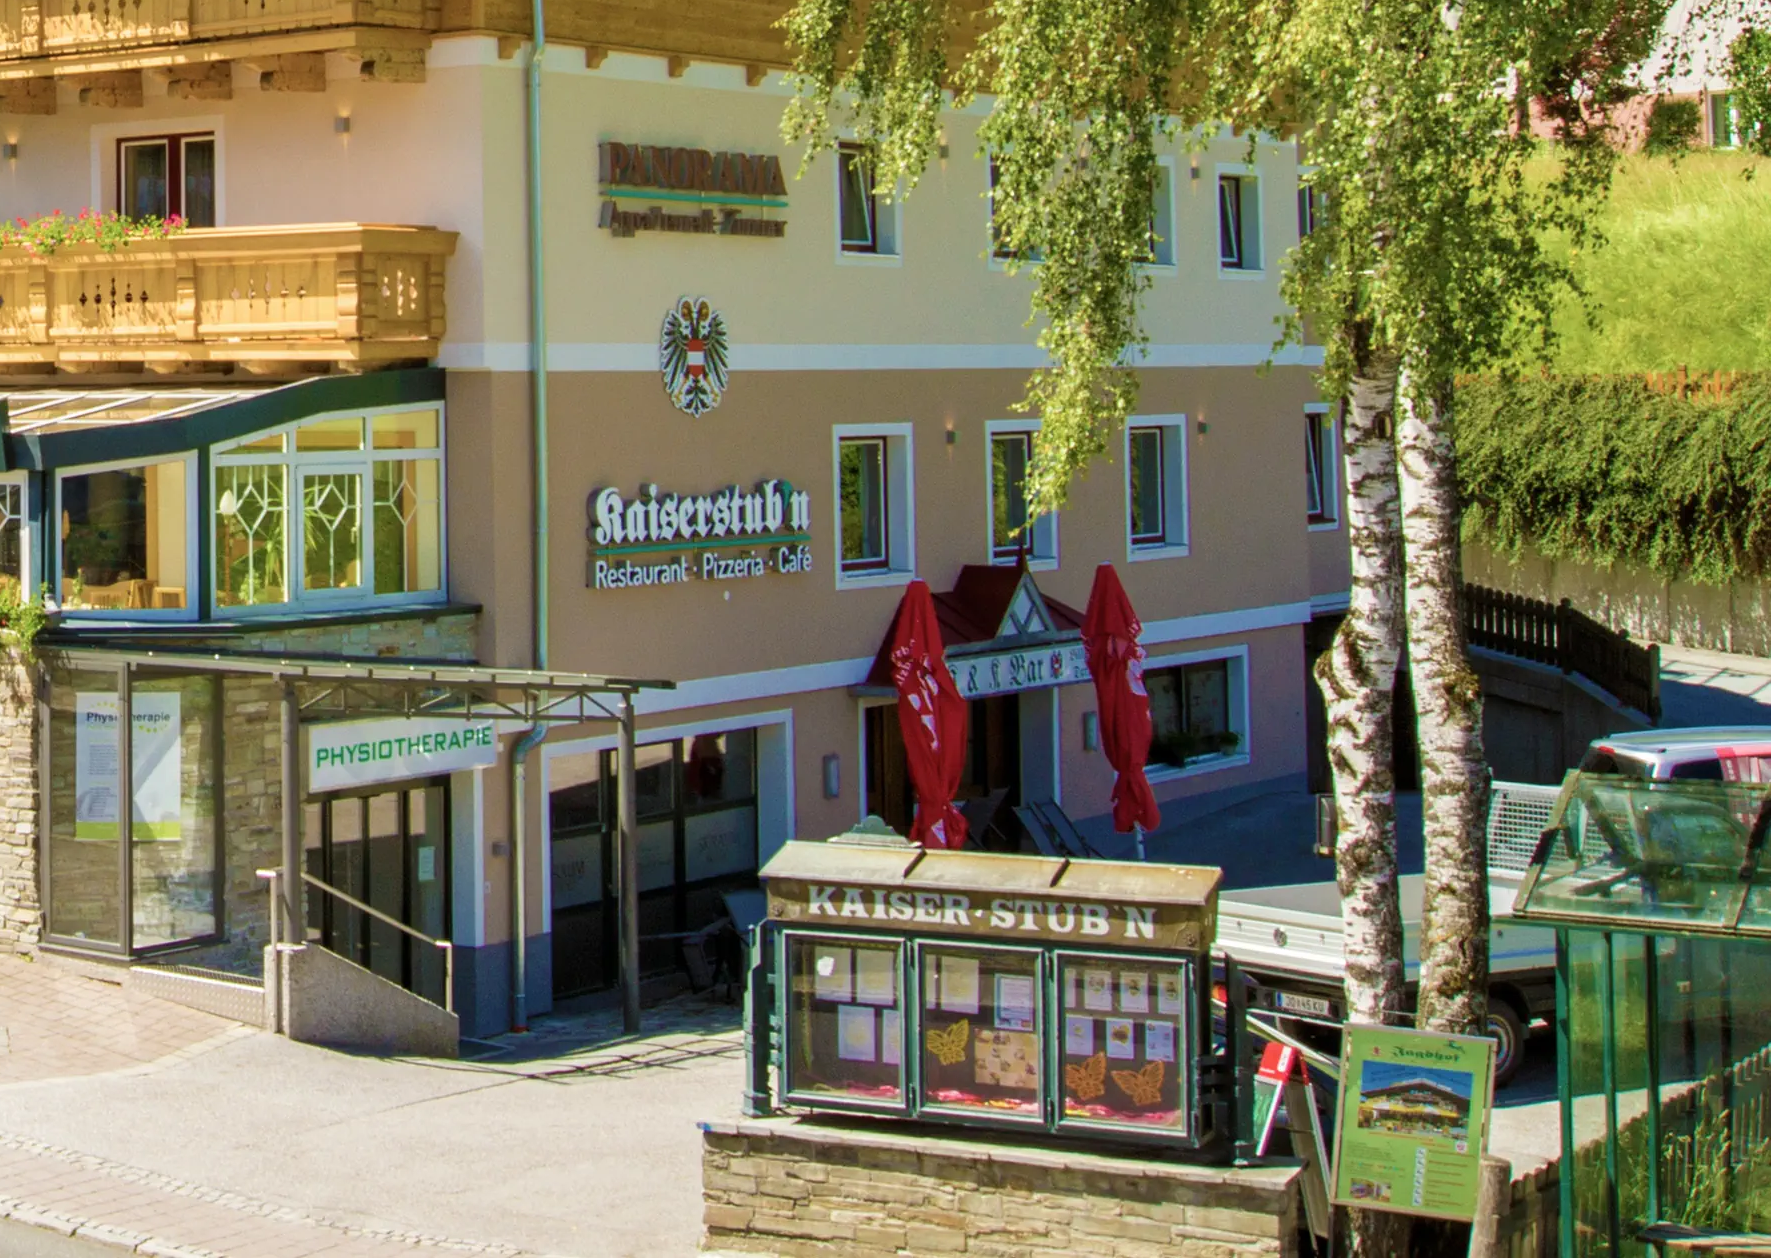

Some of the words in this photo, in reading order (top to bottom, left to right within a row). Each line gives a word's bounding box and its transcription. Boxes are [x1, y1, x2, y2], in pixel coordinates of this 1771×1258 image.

[606, 142, 788, 195] PANORAMA
[596, 479, 811, 545] Kaiserstub'n
[595, 556, 688, 589] Restaurant
[703, 549, 764, 580] Pizzeria
[779, 545, 812, 574] Café
[1009, 653, 1043, 687] Bar
[86, 711, 171, 724] Physiherapie
[316, 727, 492, 769] PHYSIOTHERAPIE
[807, 885, 972, 926] KAISER
